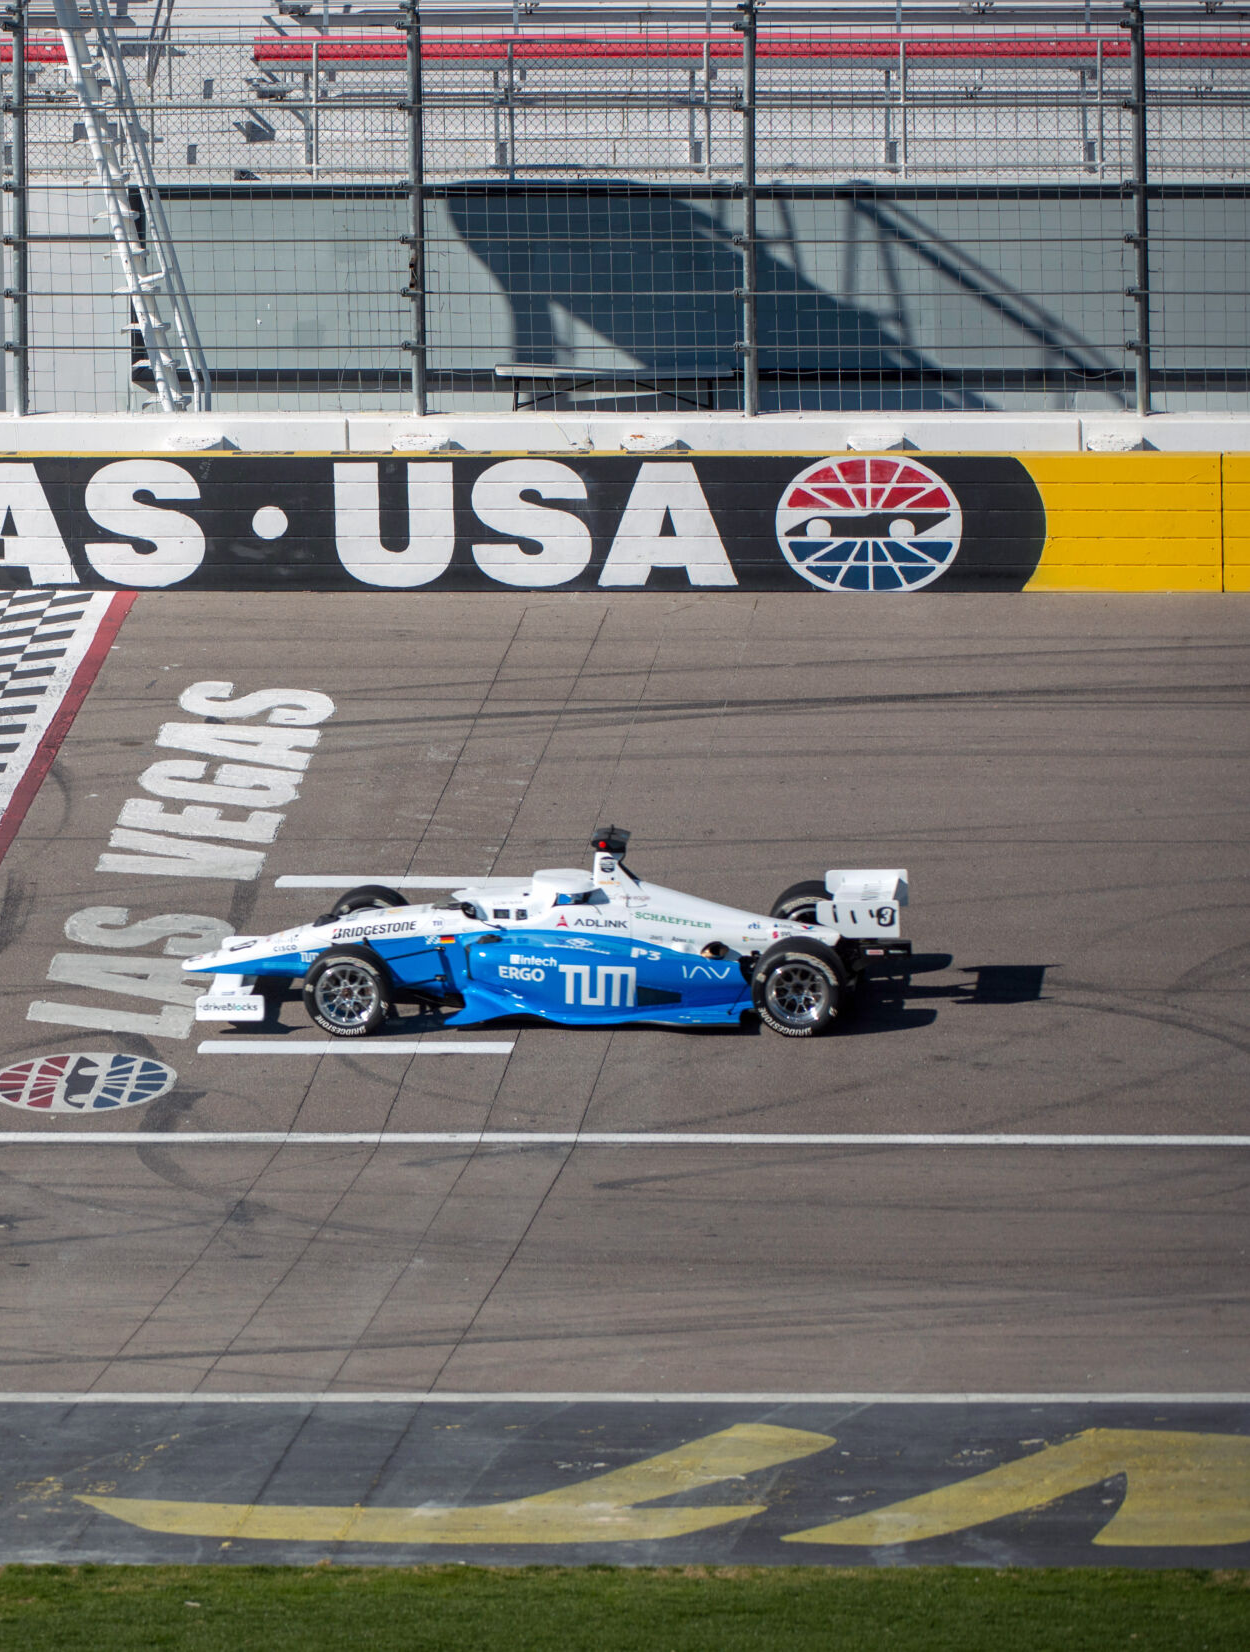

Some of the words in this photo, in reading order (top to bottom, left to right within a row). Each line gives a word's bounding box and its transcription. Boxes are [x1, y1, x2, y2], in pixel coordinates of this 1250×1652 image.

[333, 458, 739, 588] USA
[94, 680, 338, 881] VEGAS
[573, 918, 629, 929] ADLINK
[633, 911, 712, 929] SCHAEFFLER
[332, 920, 418, 939] BRIDGESTONE
[630, 947, 662, 961] P3
[26, 905, 236, 1040] LAS
[498, 965, 546, 982] ERGO
[682, 965, 731, 979] IAV
[558, 964, 637, 1007] TUM
